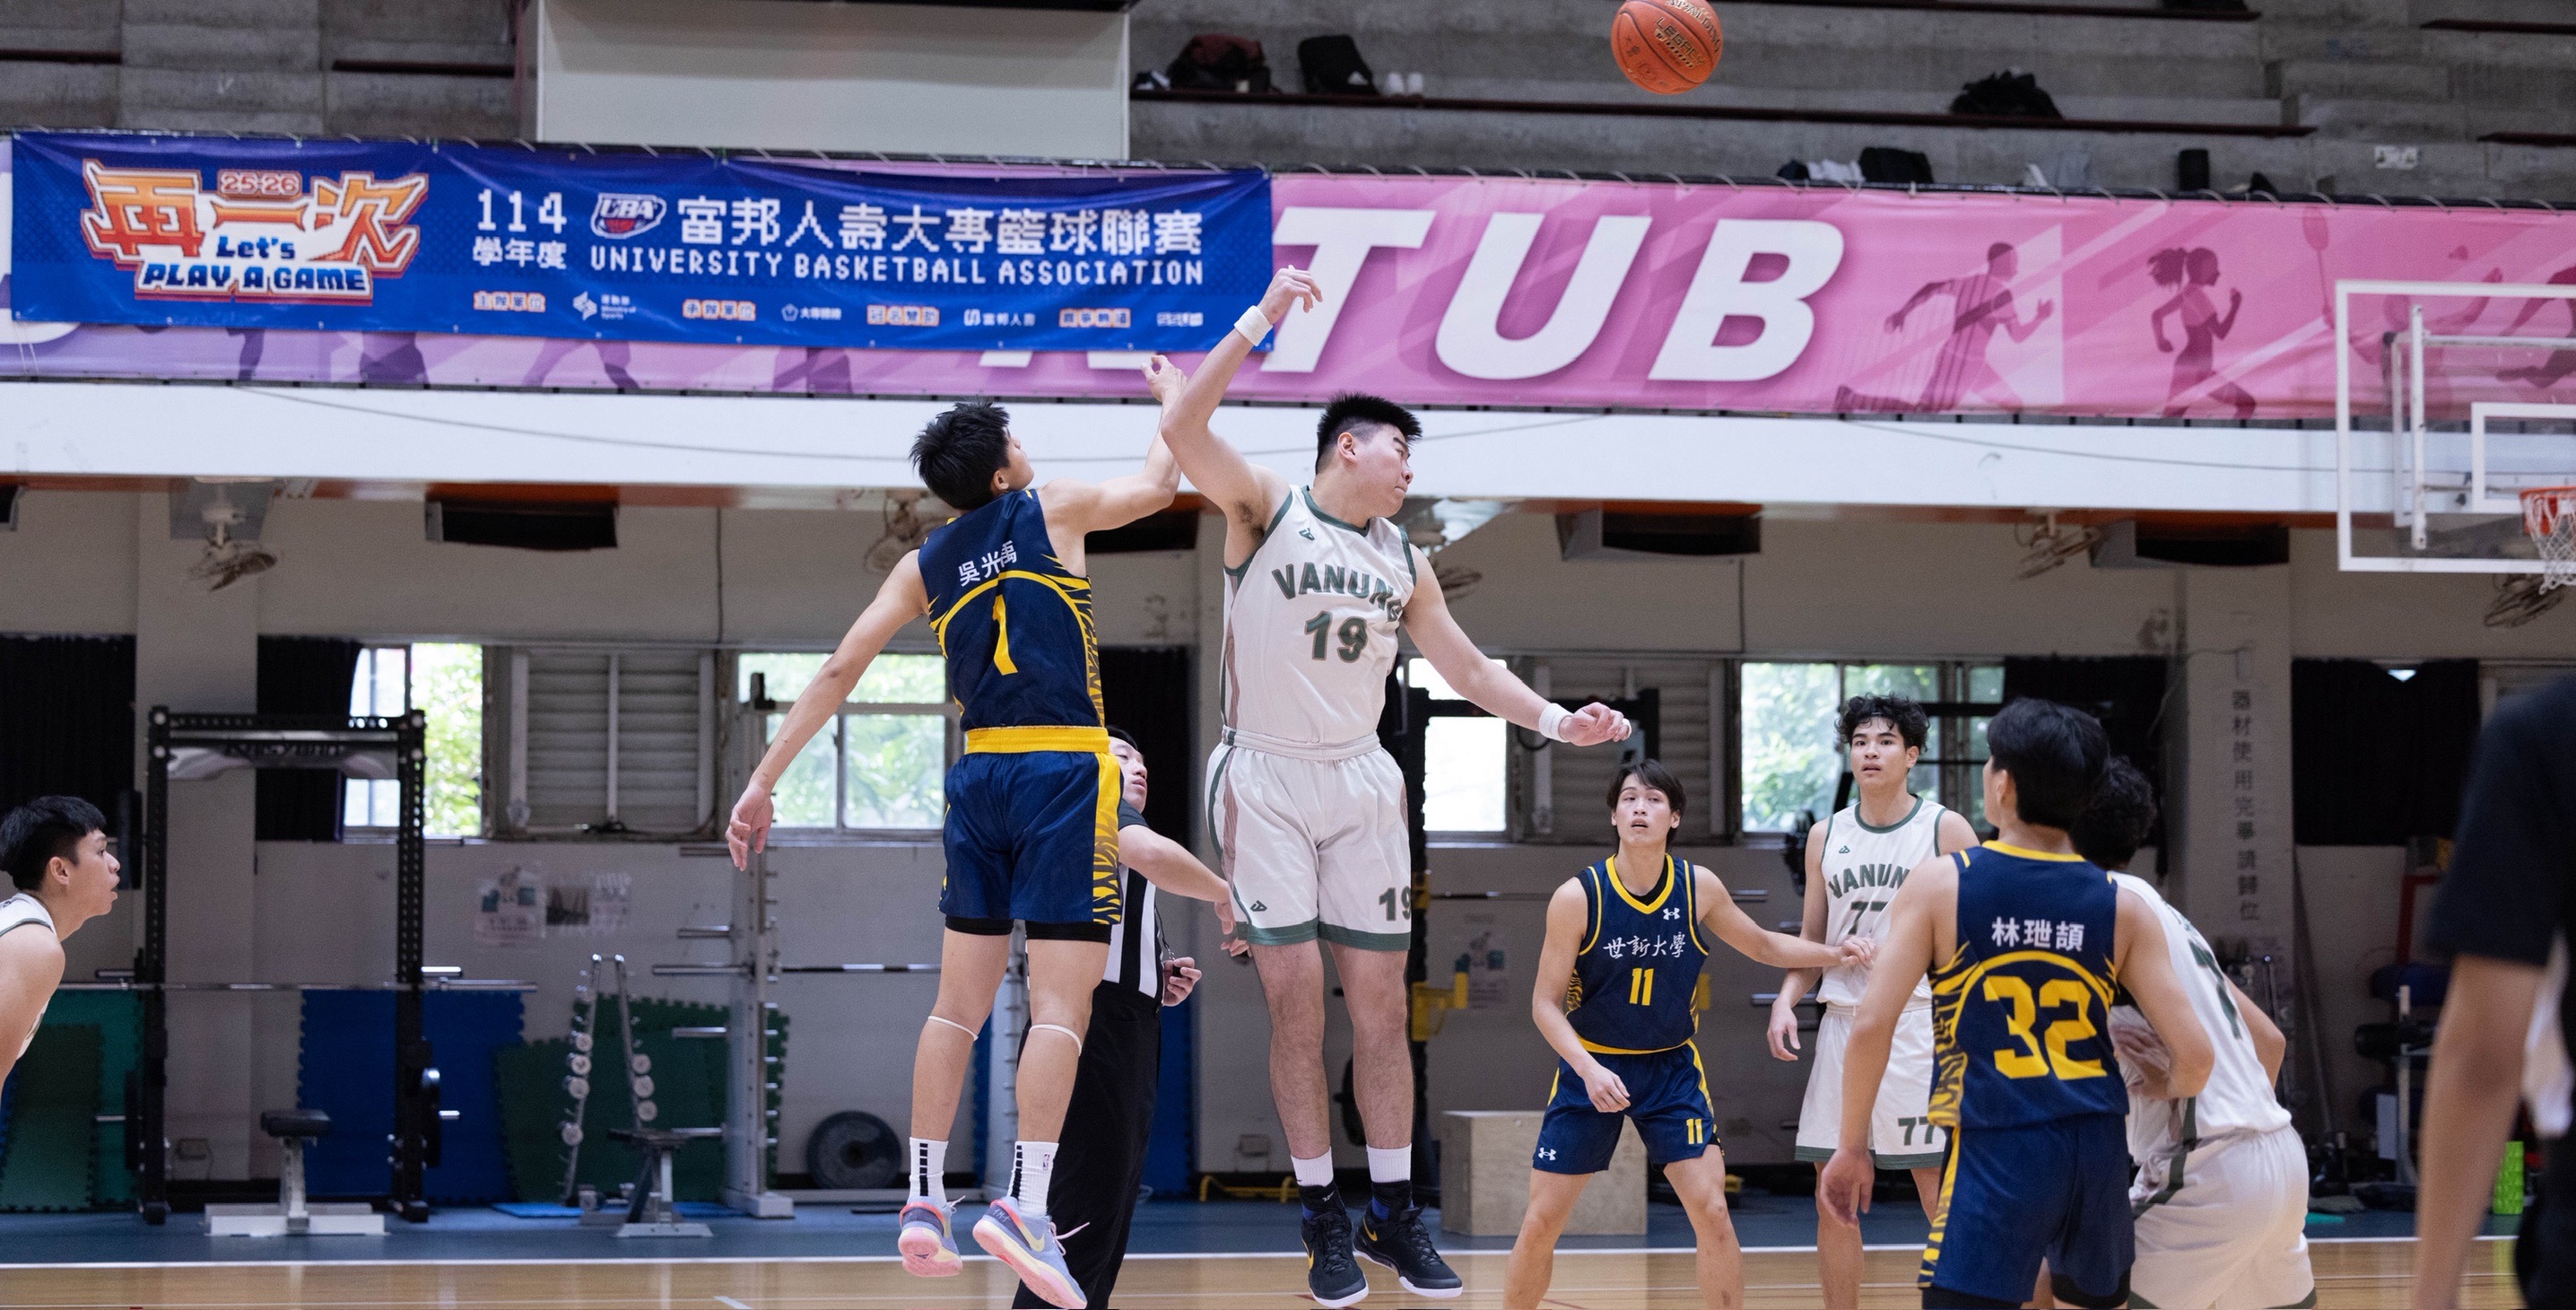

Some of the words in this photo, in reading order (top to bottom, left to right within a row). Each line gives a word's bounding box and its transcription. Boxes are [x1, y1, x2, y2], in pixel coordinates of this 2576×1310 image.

[1656, 16, 1705, 66] LEGACY
[222, 173, 298, 194] 25-26
[87, 170, 422, 264] 再一次
[477, 188, 568, 234] 114
[677, 196, 1204, 257] 富邦人壽大專籃球聯賽
[216, 236, 295, 259] Let's
[472, 236, 567, 270] 學年度
[590, 245, 783, 277] UNIVERSITY
[794, 249, 987, 284] BASKETBALL
[998, 258, 1204, 285] ASSOCIATION
[143, 263, 231, 287] PLAY
[243, 266, 264, 289] A
[274, 266, 366, 291] GAME
[979, 205, 1845, 381] TUB
[958, 539, 1018, 588] 吳光禹
[992, 593, 1019, 677] 1
[1304, 610, 1369, 664] 19
[1603, 931, 1686, 960] 世新大學
[1629, 967, 1655, 1006] 11
[1982, 974, 2108, 1080] 32
[1686, 1118, 1703, 1145] 11
[1897, 1116, 1936, 1147] 77
